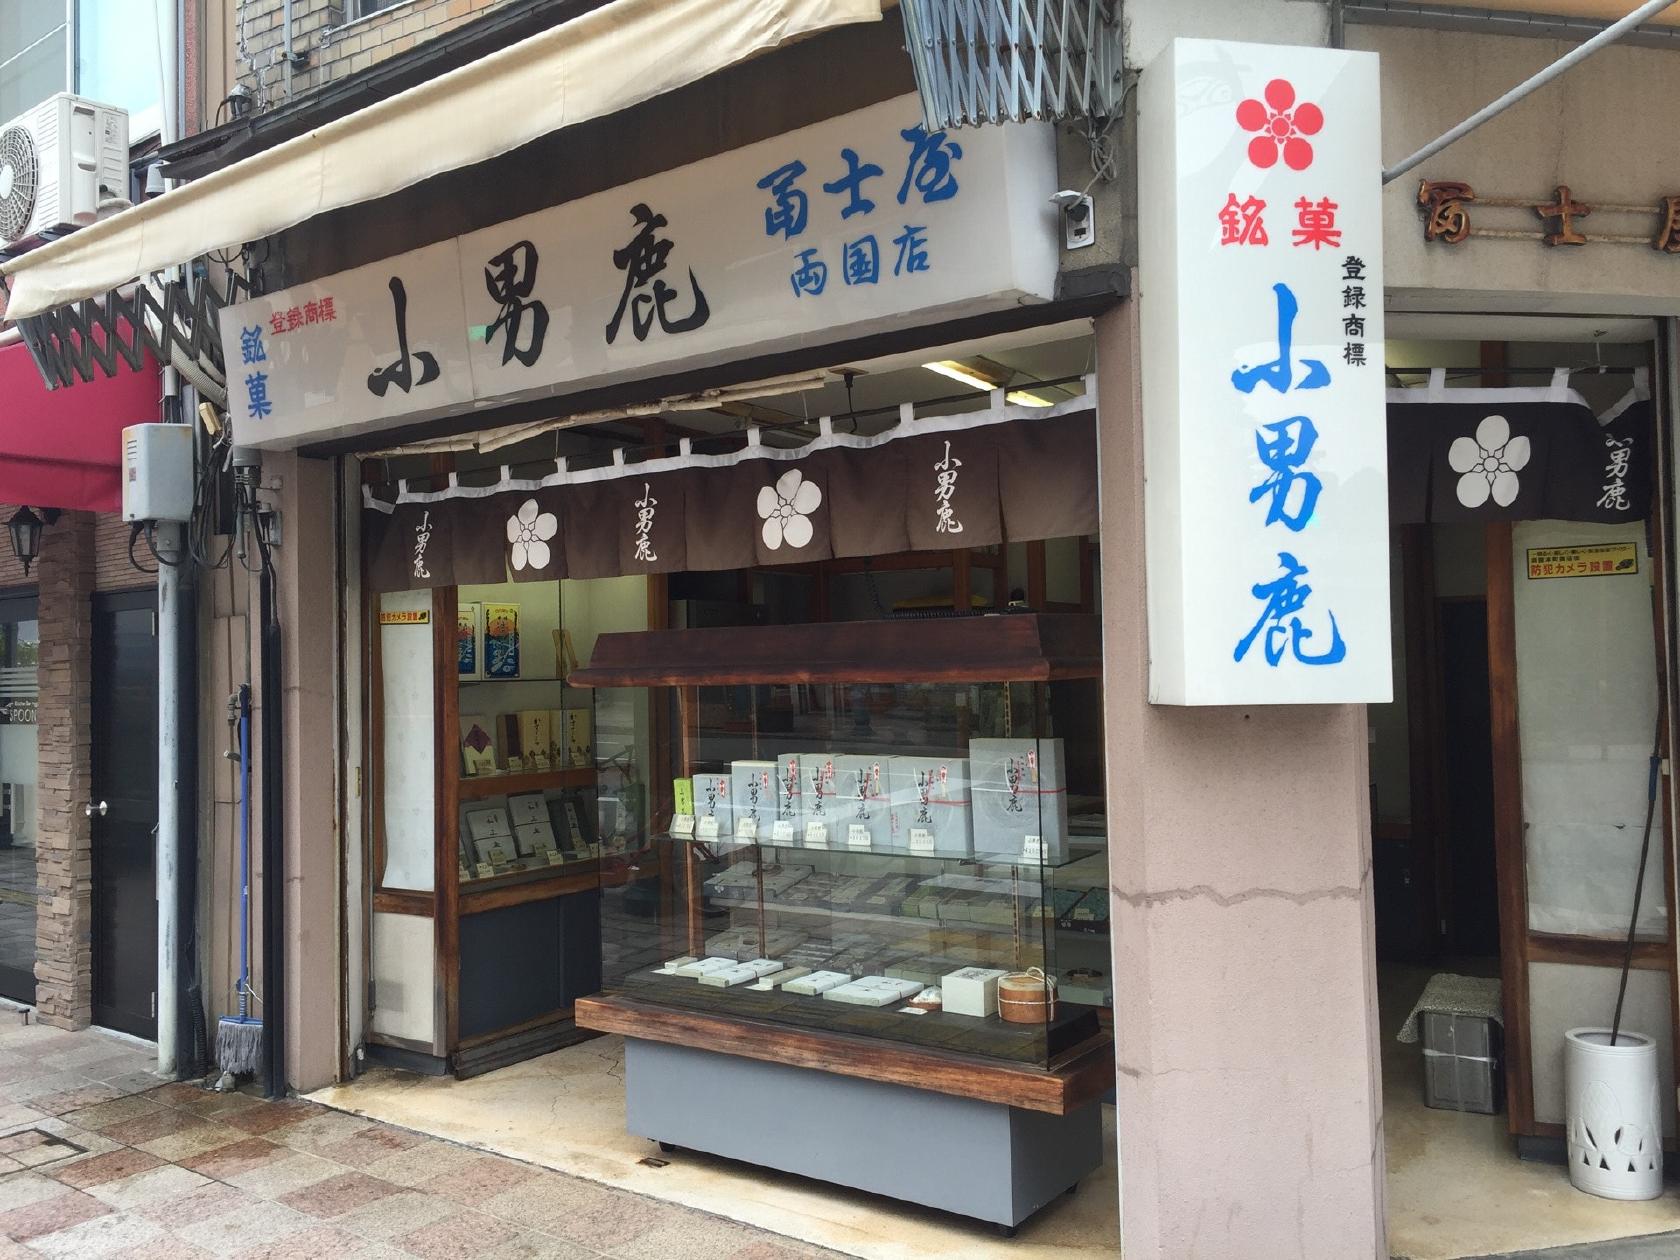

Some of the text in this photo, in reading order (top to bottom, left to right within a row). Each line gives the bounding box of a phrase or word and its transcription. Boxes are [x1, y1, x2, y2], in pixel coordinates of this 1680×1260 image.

[791, 224, 931, 298] 両国店
[1218, 192, 1342, 251] 銘菓
[269, 296, 337, 336] 登録商標
[367, 203, 711, 397] 小男鹿
[1341, 255, 1367, 367] 登録商標
[240, 324, 272, 420] 銘菓
[933, 440, 963, 534] 小男鹿
[1231, 282, 1346, 668] 小男鹿
[413, 511, 433, 578] 小男鹿
[634, 482, 658, 562] 小男鹿
[1530, 560, 1614, 577] 防犯カメラ設置
